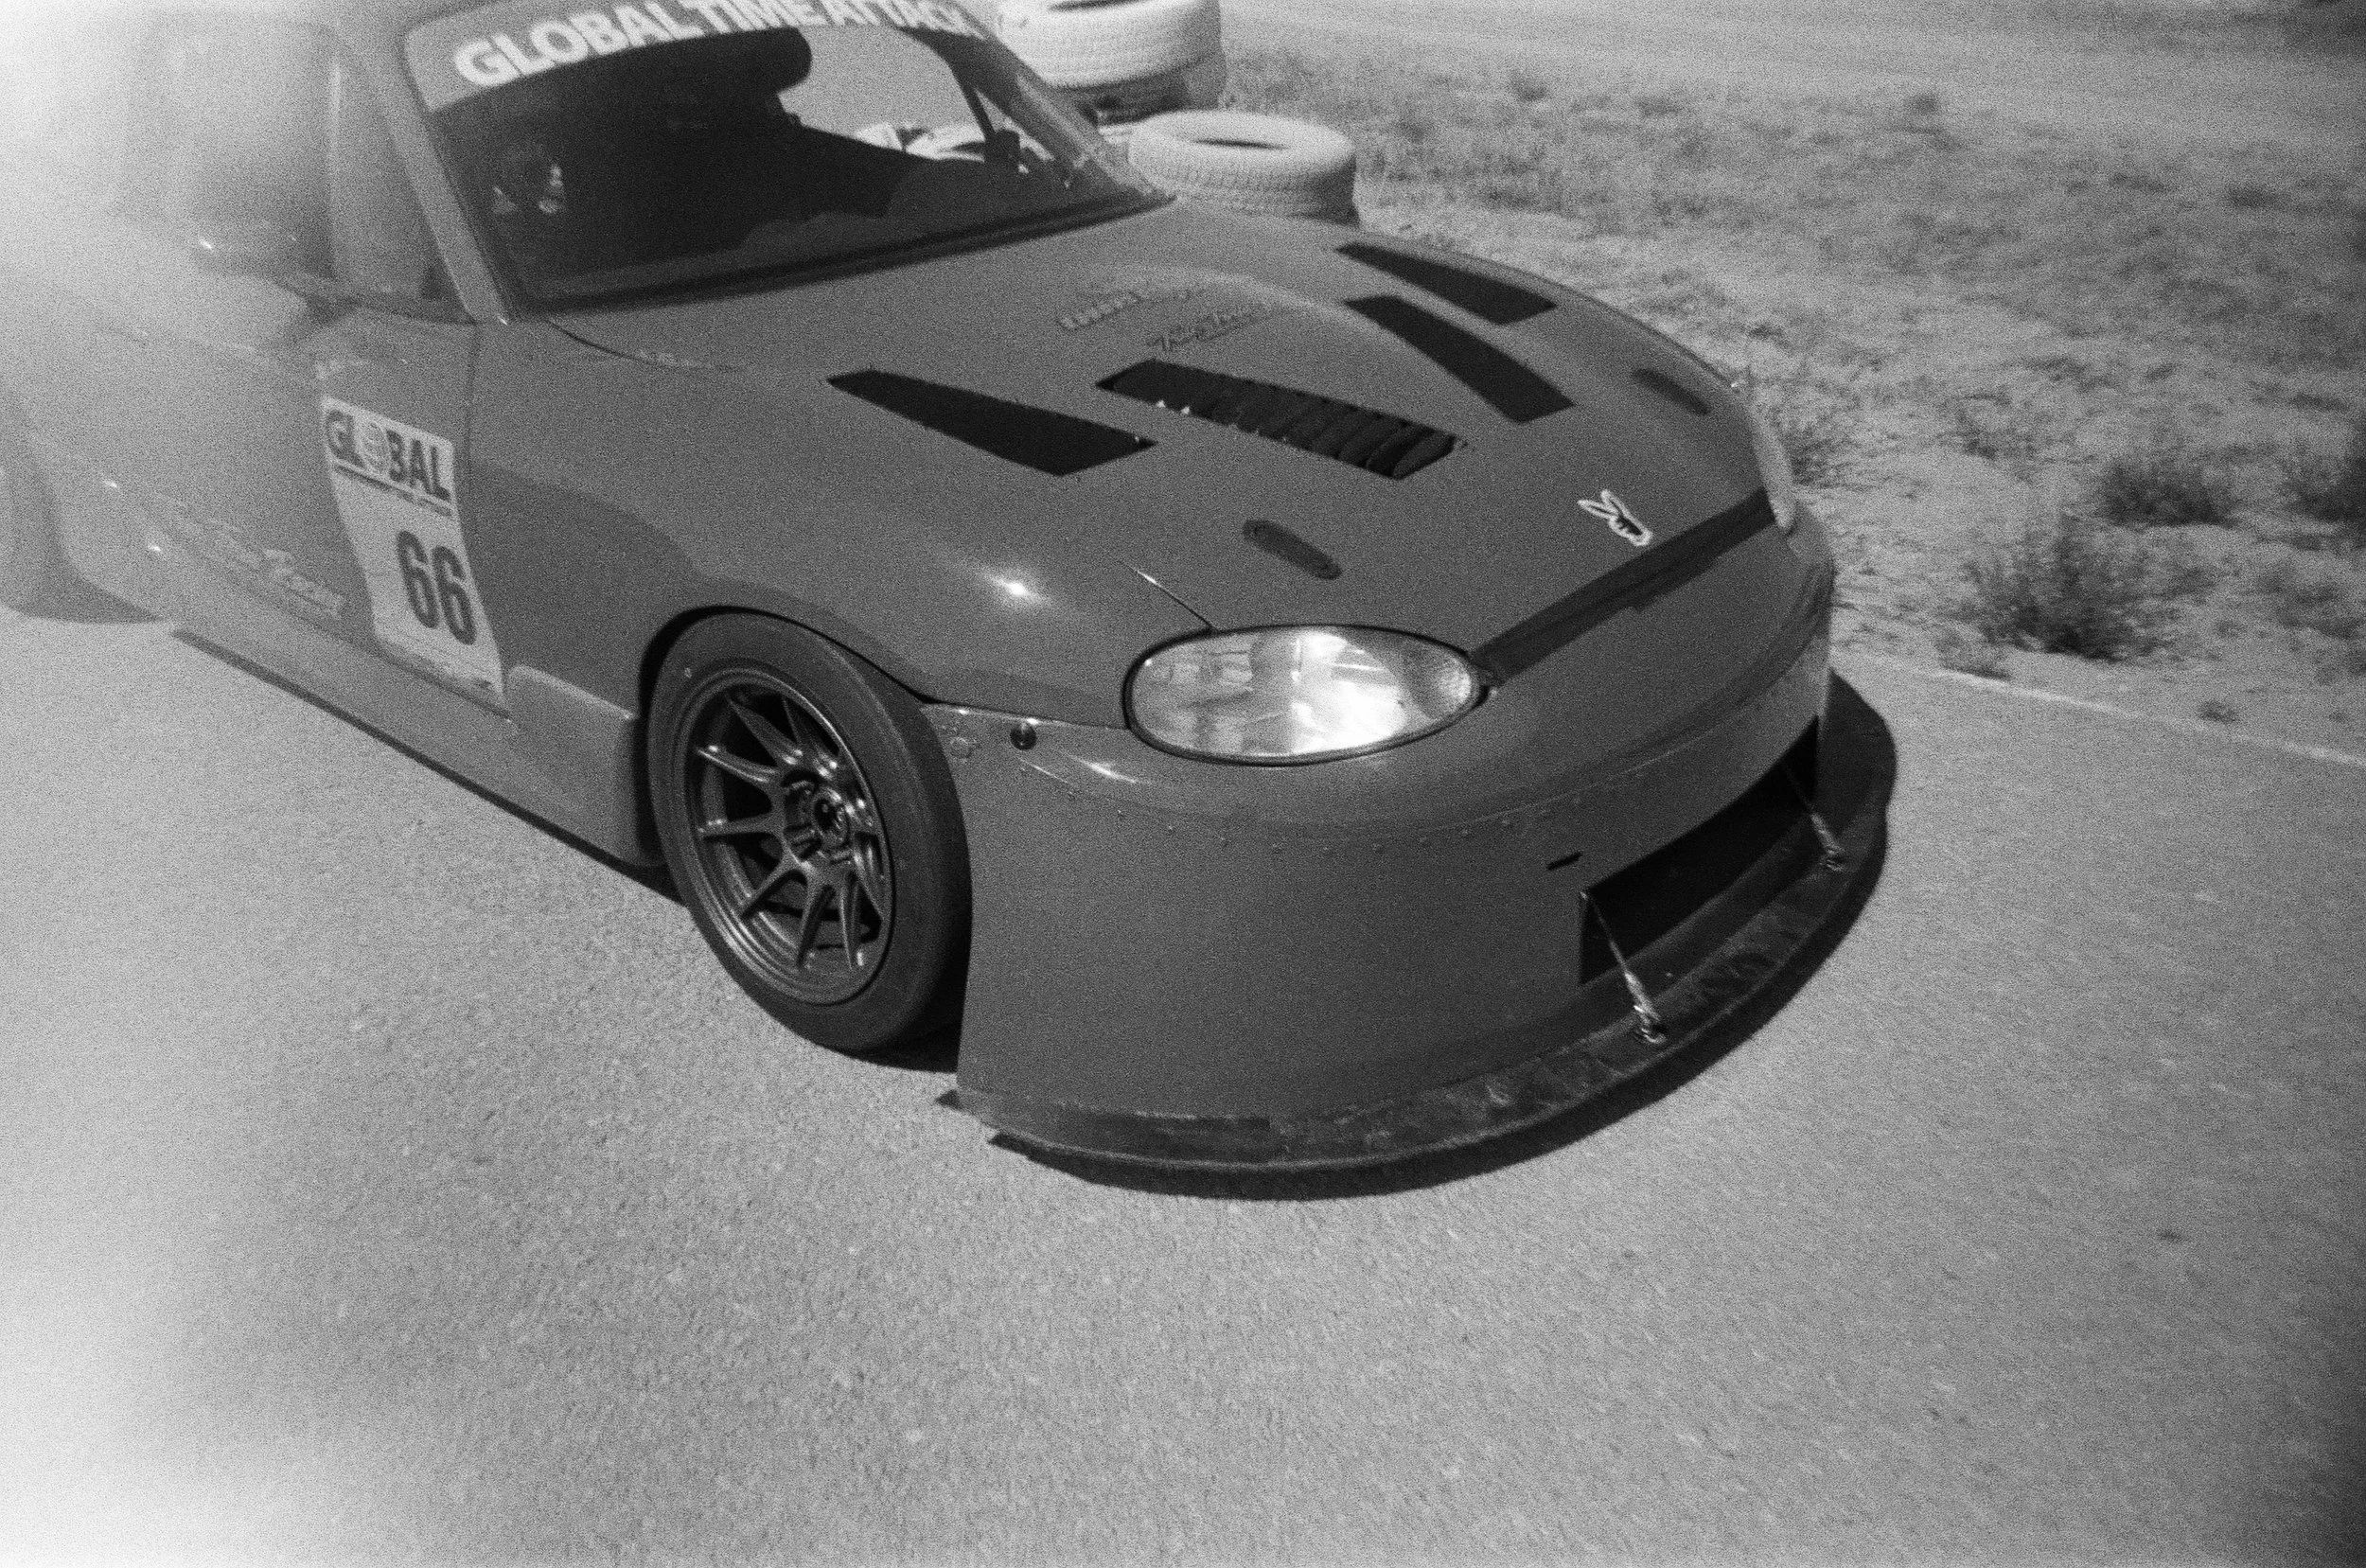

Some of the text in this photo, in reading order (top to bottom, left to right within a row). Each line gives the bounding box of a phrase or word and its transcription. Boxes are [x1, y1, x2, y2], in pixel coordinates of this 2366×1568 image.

[453, 1, 705, 88] GLOBAL
[678, 0, 828, 34] TIME
[326, 409, 451, 502] GLOBAL
[396, 529, 475, 646] 66
